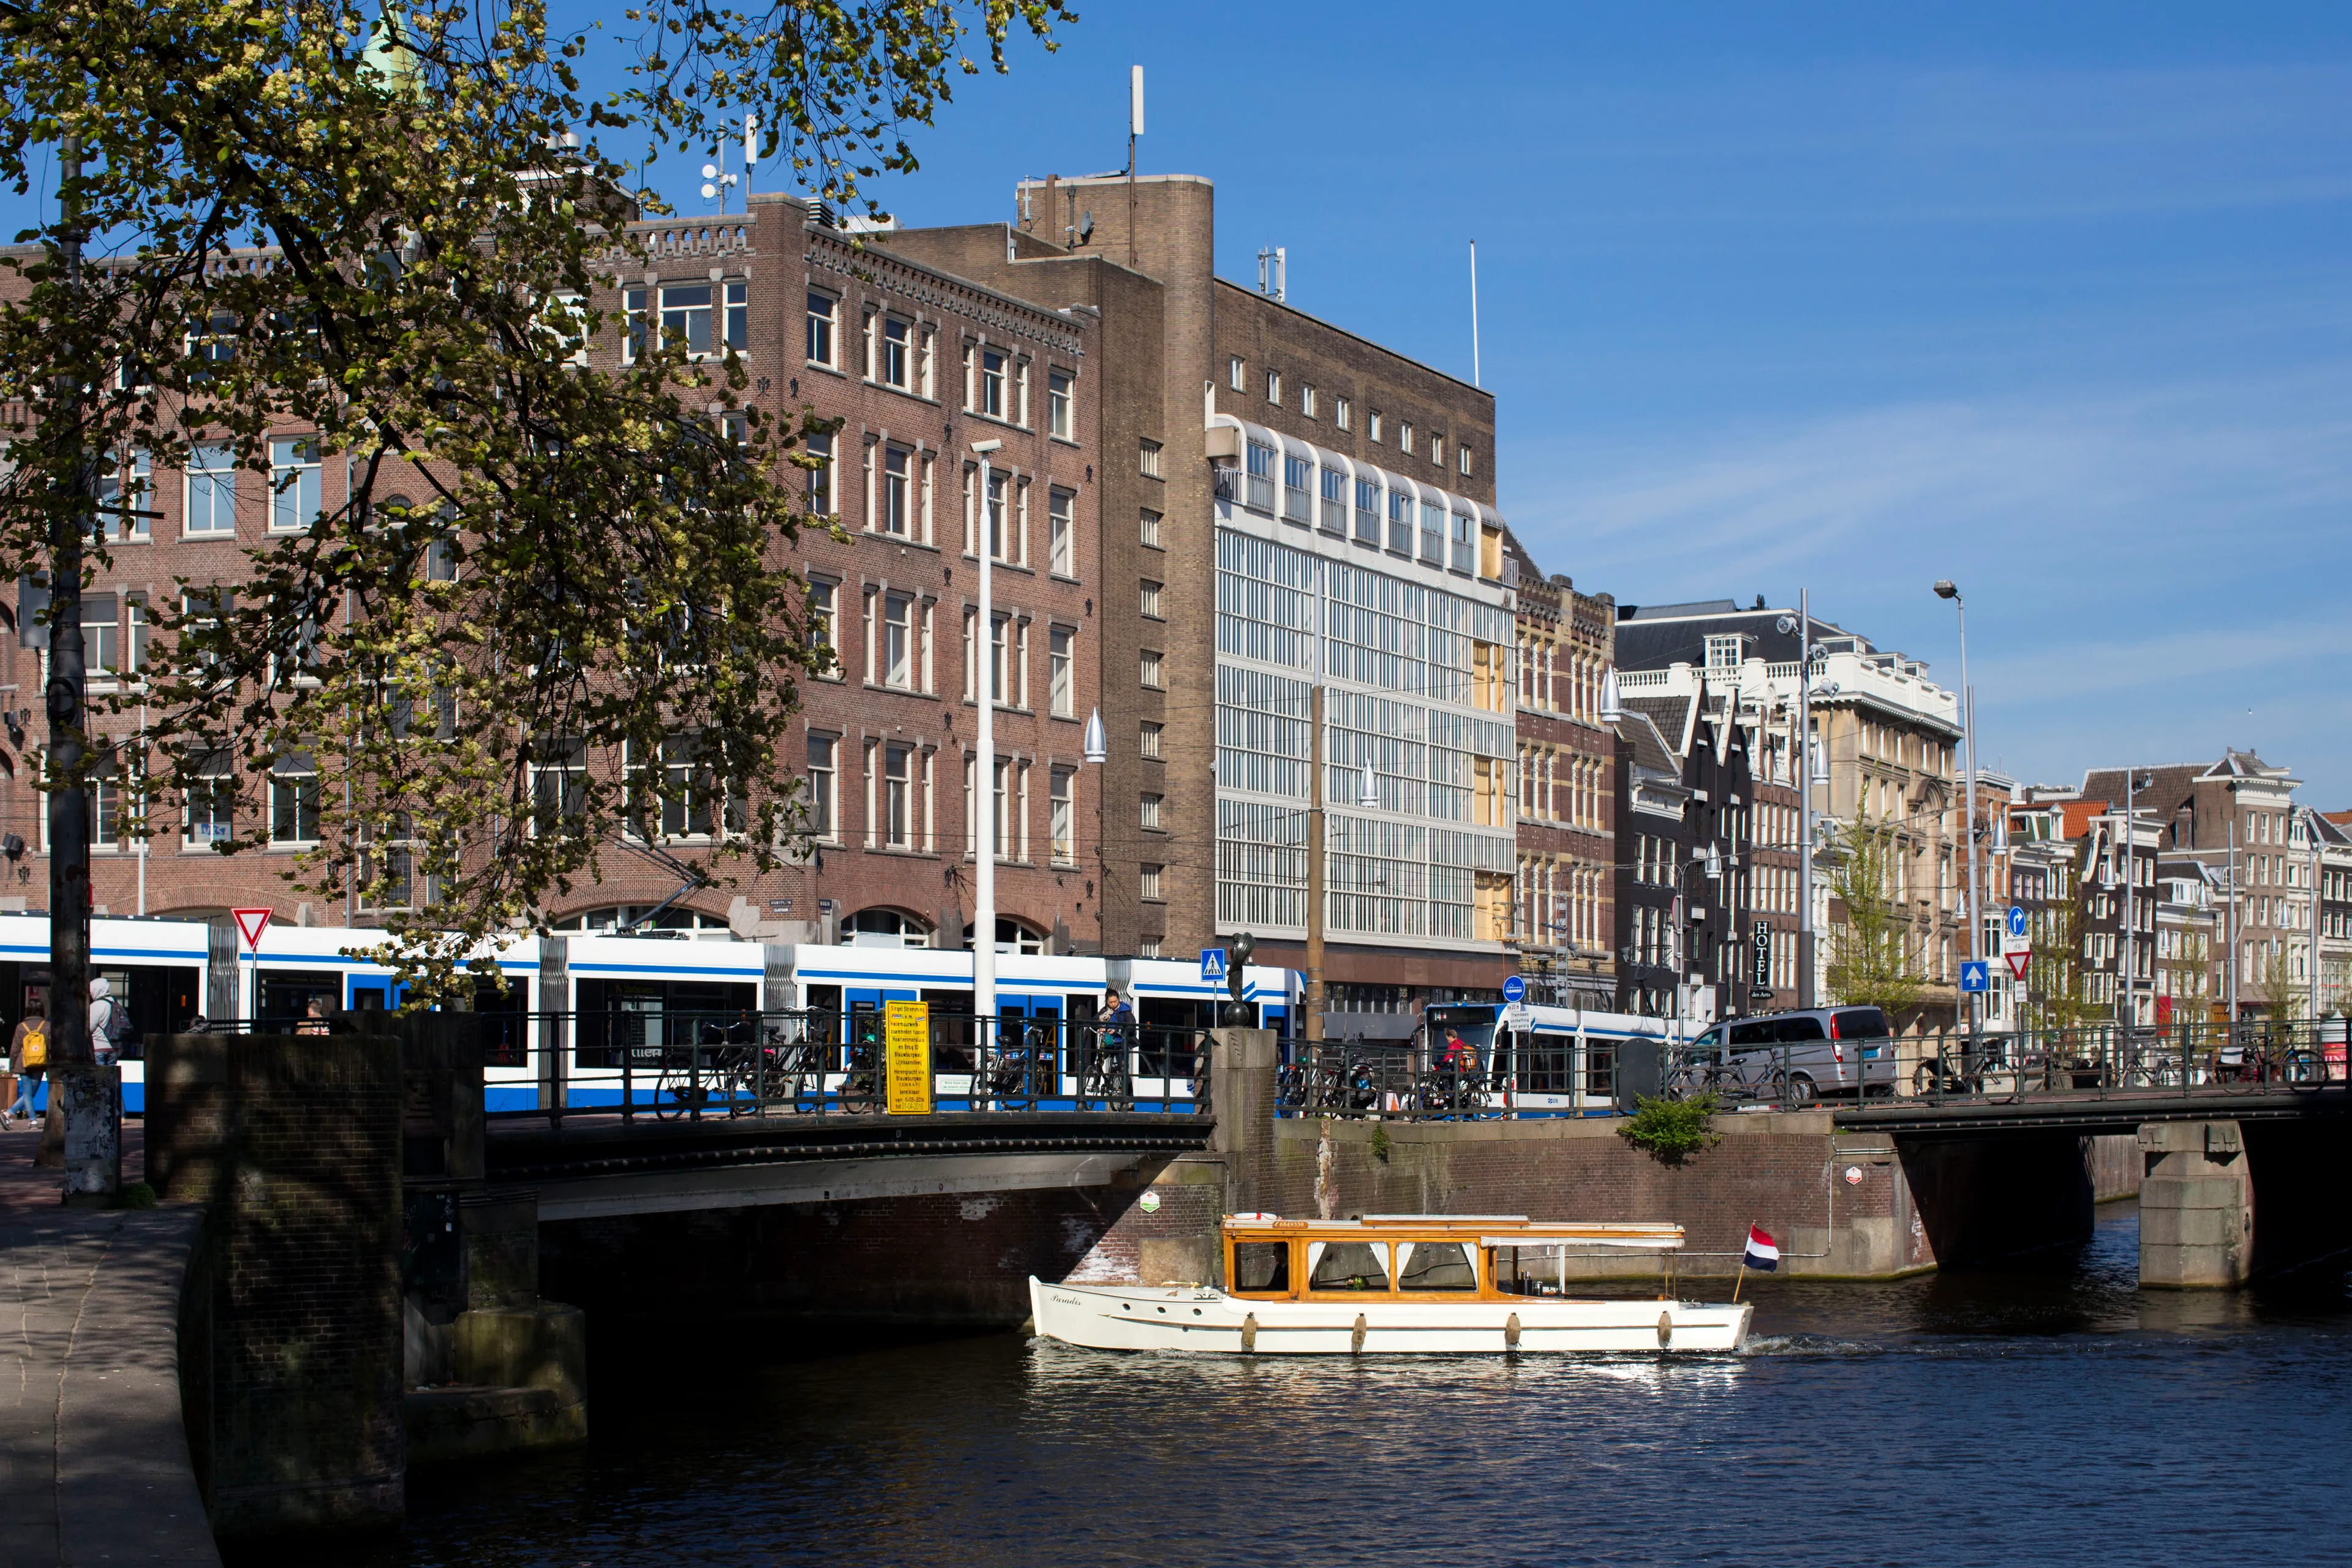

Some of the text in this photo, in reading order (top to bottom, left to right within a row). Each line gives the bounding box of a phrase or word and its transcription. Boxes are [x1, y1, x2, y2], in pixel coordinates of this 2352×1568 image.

[1756, 922, 1768, 985] HOTEL
[1434, 1010, 1441, 1020] 14
[1050, 1293, 1080, 1305] Paradis
